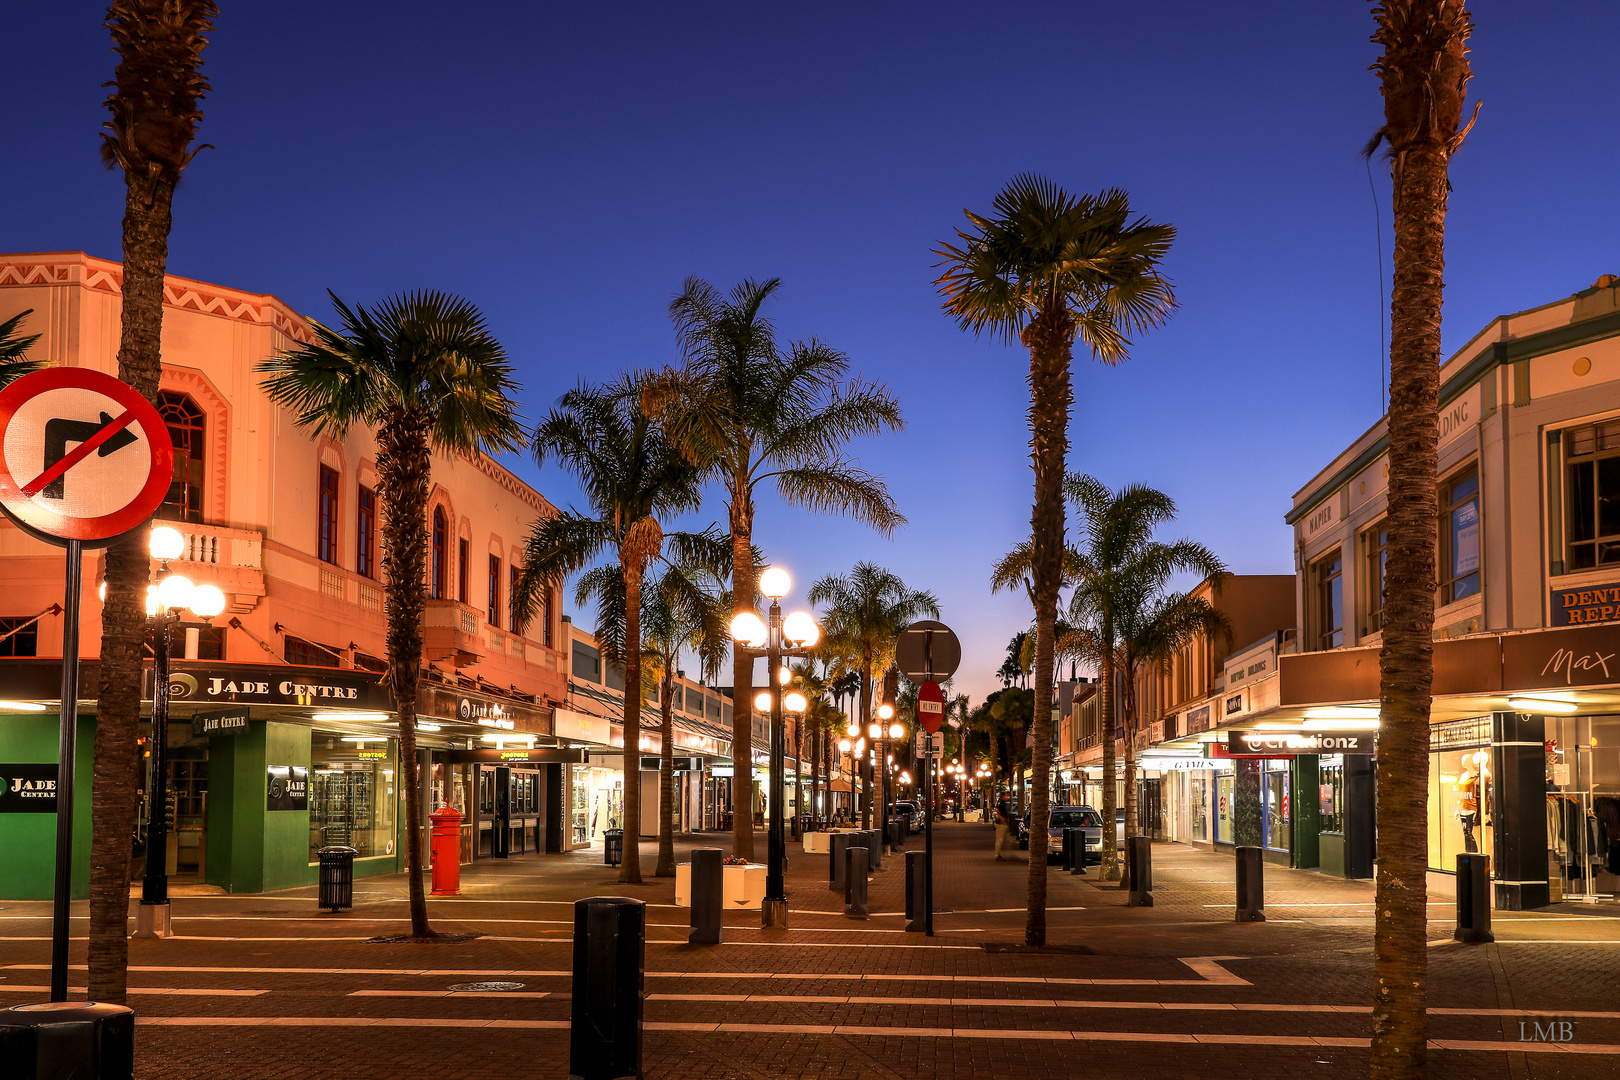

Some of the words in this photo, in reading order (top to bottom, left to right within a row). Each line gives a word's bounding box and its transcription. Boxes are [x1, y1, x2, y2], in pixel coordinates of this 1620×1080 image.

[1309, 505, 1331, 535] NAPIER
[1541, 648, 1615, 684] Max
[207, 677, 269, 695] JADE
[279, 681, 358, 699] CENTRE
[923, 702, 928, 711] NO
[929, 703, 939, 712] ENTRY
[203, 717, 219, 732] JADE
[220, 715, 246, 729] CENTRE
[11, 778, 56, 792] JADE
[285, 779, 306, 792] JADE
